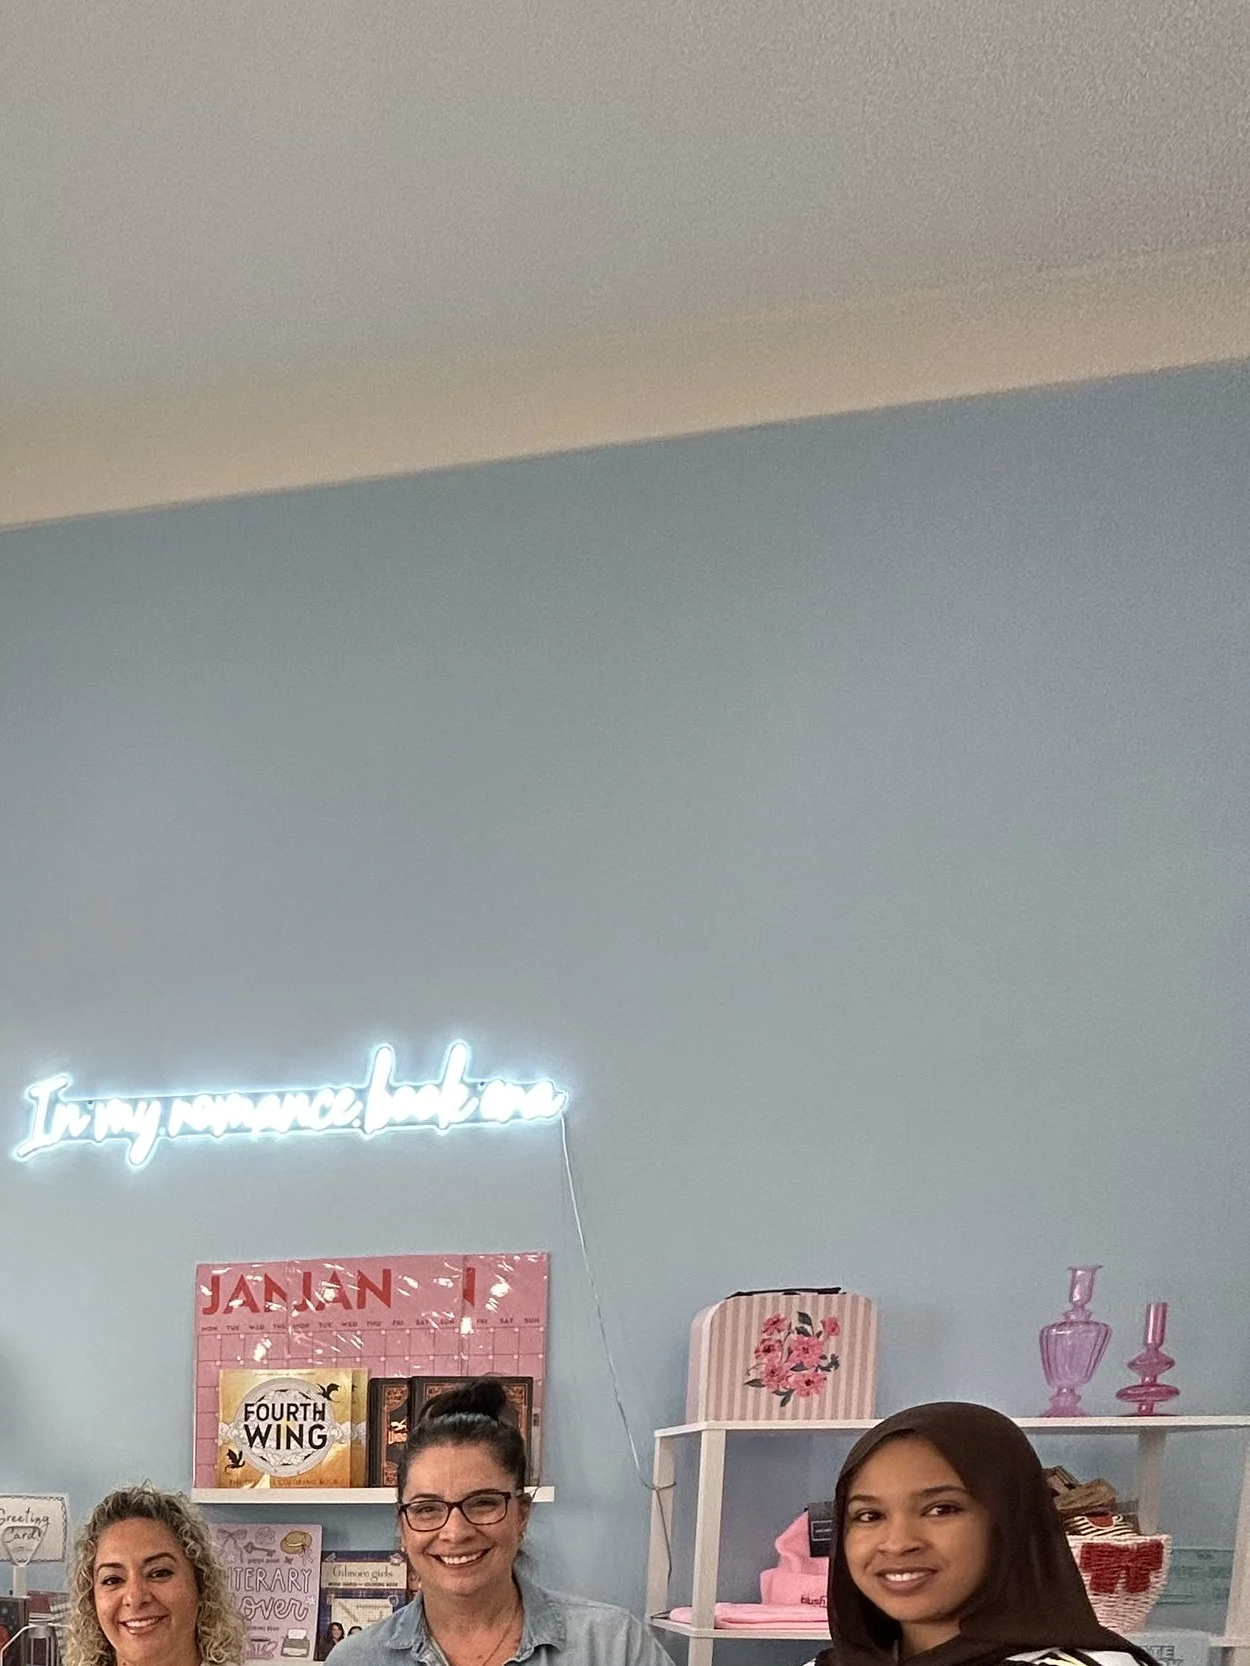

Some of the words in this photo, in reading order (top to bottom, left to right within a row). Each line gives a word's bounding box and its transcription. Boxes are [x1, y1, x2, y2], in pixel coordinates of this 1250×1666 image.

[17, 1075, 90, 1160] In
[94, 1097, 160, 1164] my
[169, 1086, 361, 1138] romance
[363, 1042, 480, 1137] book
[296, 1268, 392, 1312] JAN
[244, 1403, 325, 1421] FOURTH
[244, 1424, 327, 1450] WING
[332, 1565, 370, 1577] Gilmore
[372, 1565, 393, 1581] girls
